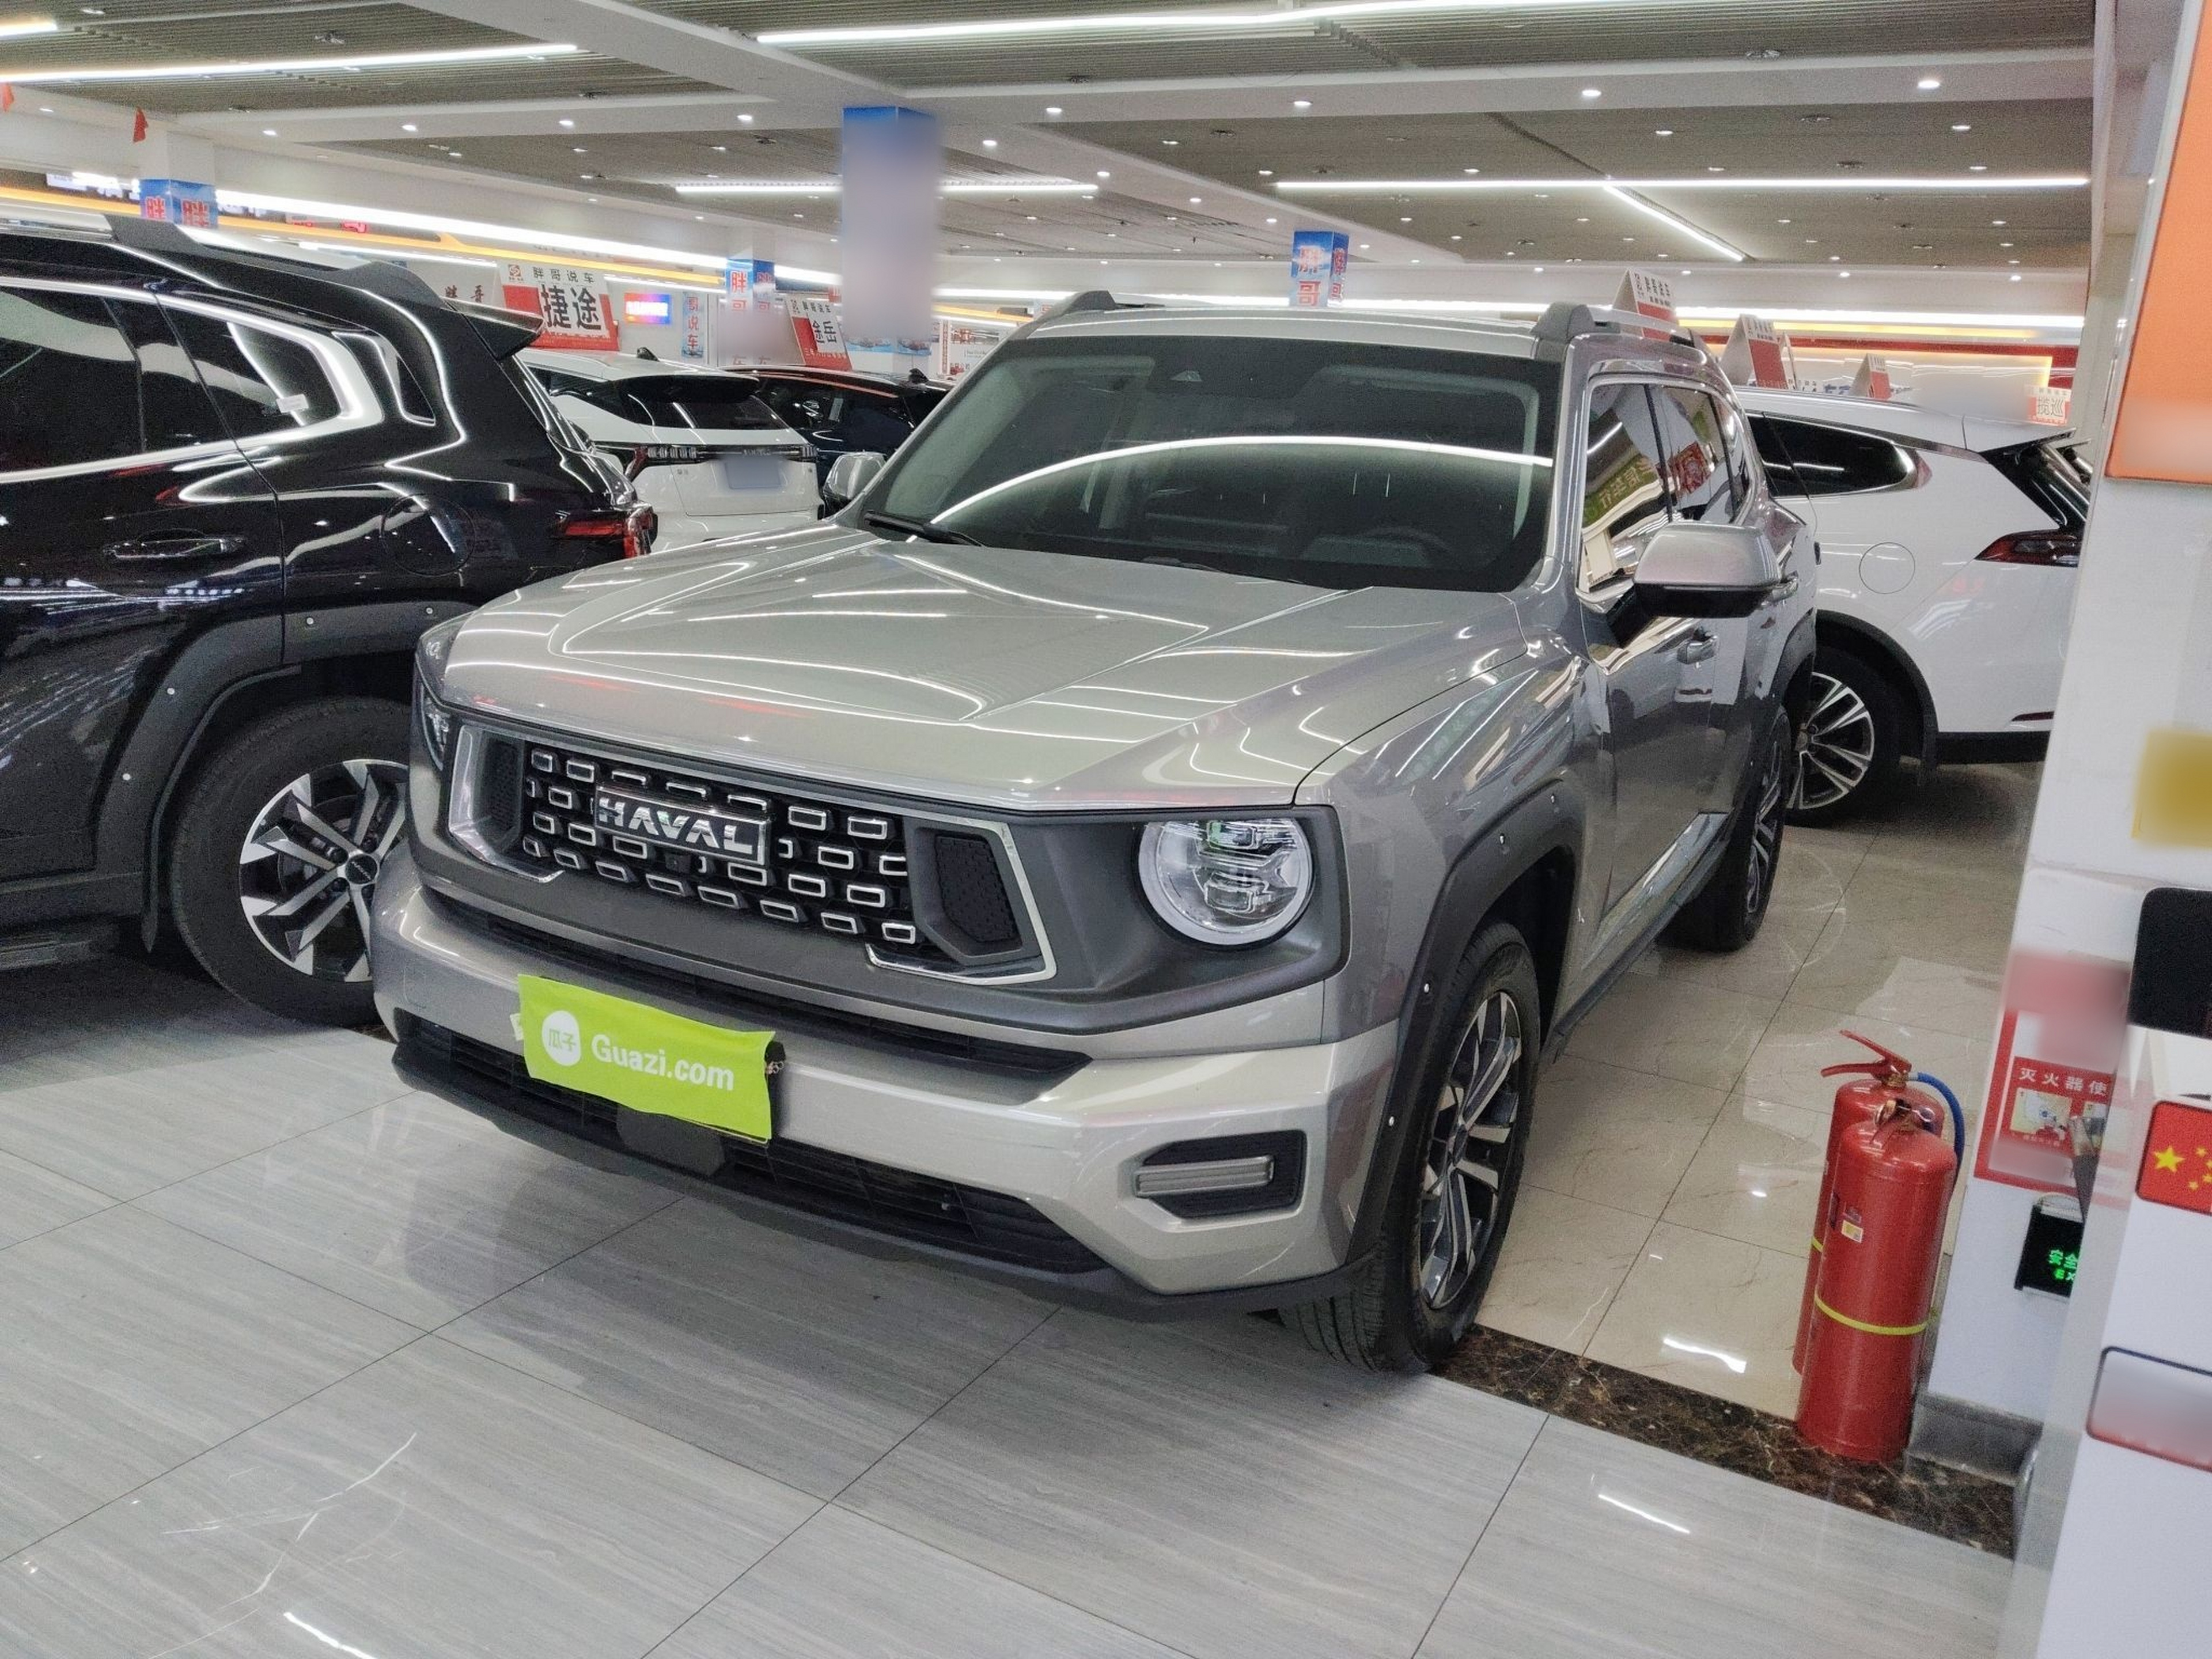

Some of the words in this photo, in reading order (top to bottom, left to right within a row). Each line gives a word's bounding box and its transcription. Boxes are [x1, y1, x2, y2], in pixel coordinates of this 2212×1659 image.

[541, 284, 601, 330] 捷途
[599, 797, 752, 854] HAVAL
[548, 1028, 576, 1052] 瓜子
[591, 1033, 734, 1091] Guazi.com
[2018, 1067, 2109, 1097] 灭火器使
